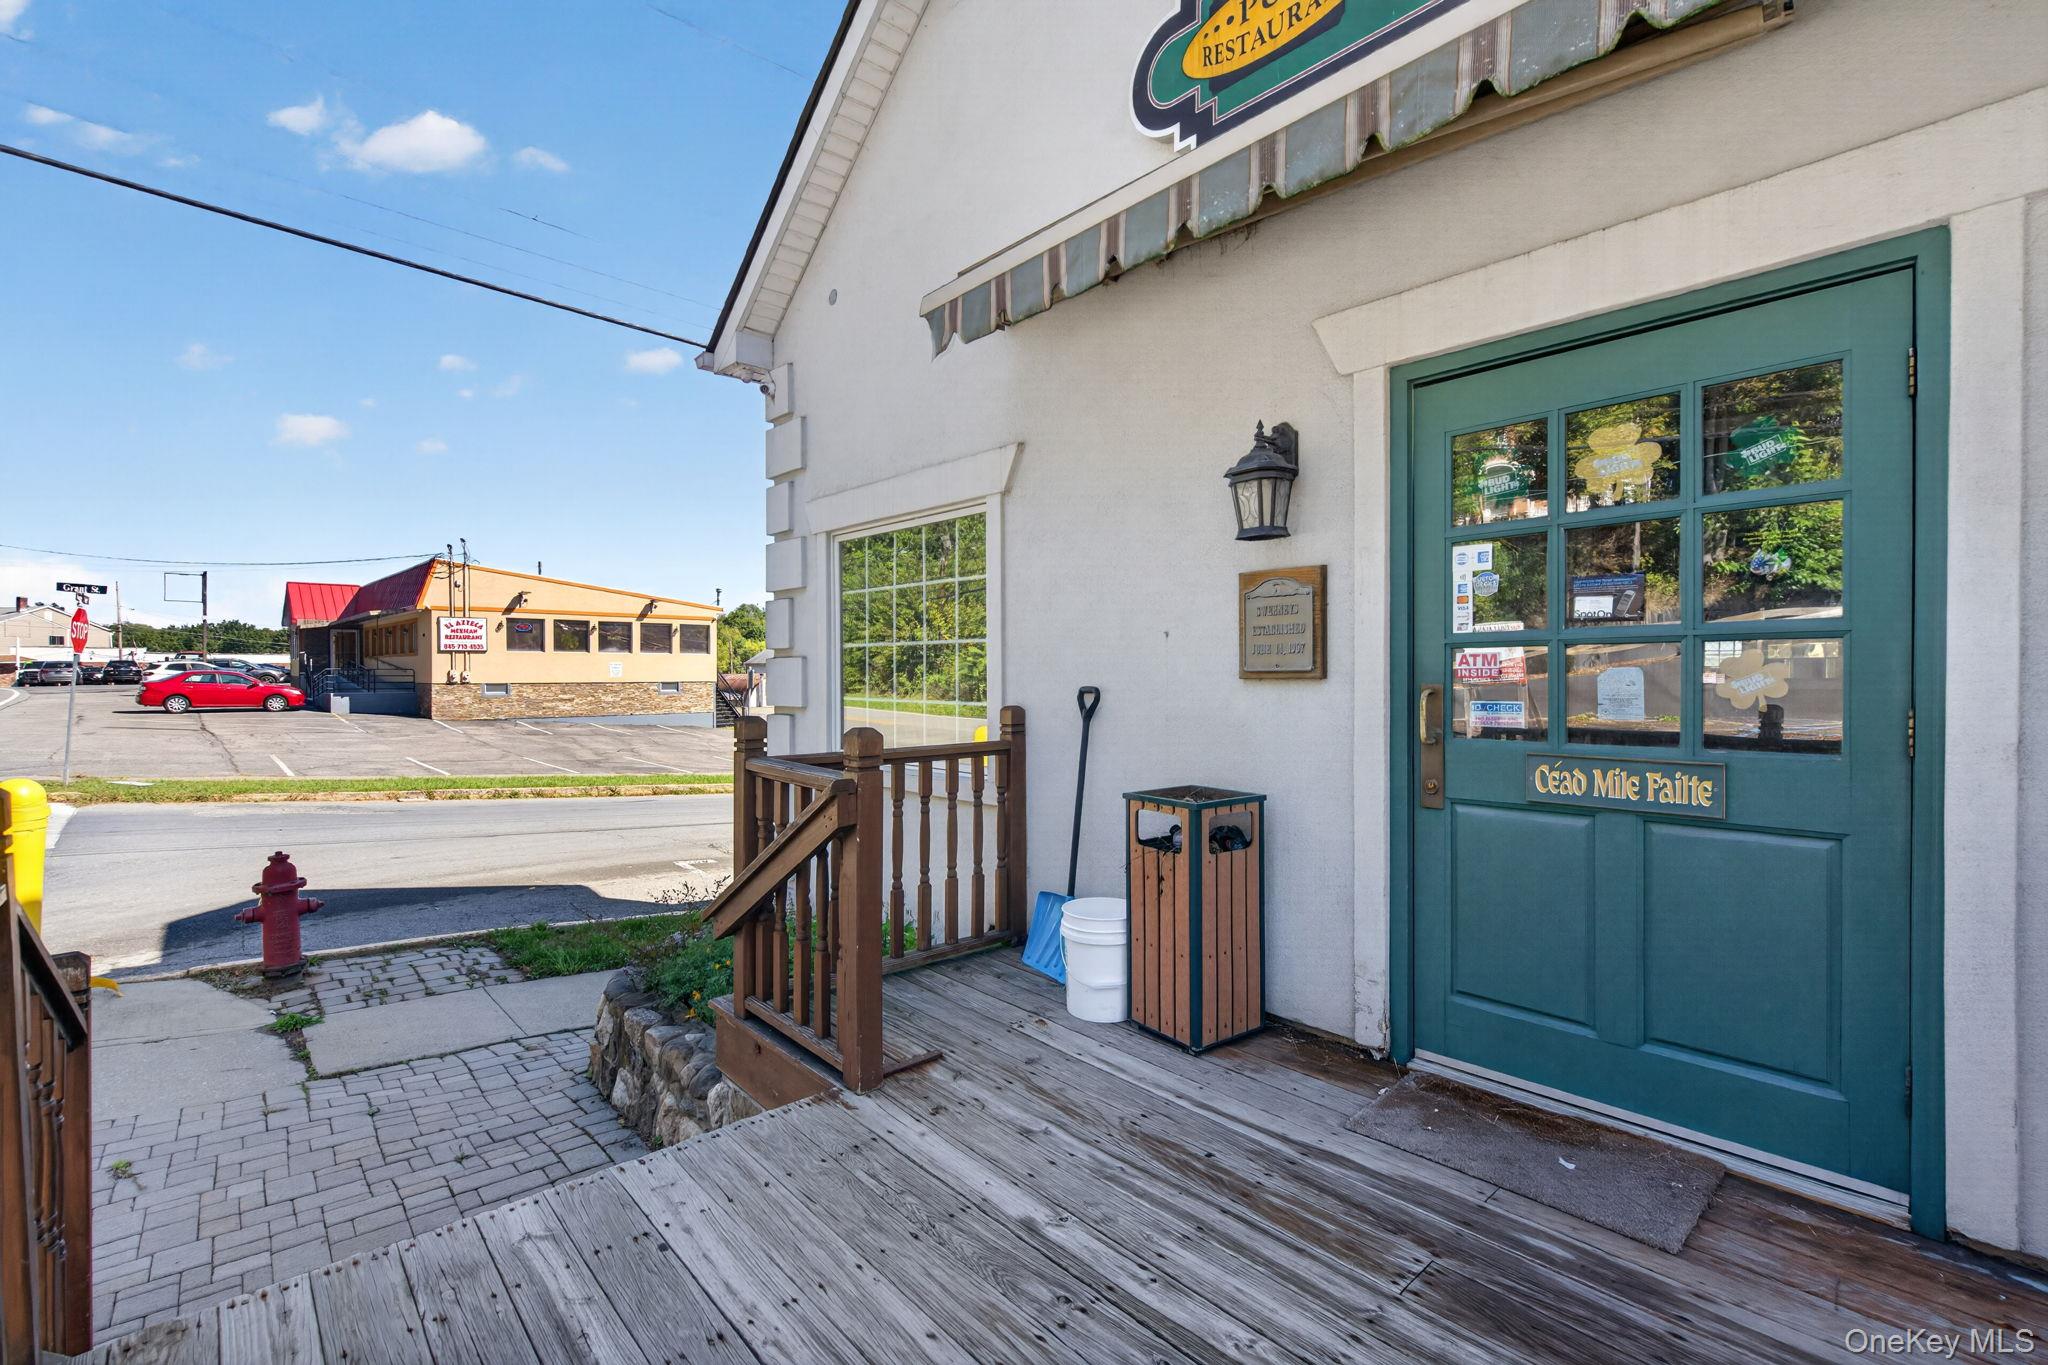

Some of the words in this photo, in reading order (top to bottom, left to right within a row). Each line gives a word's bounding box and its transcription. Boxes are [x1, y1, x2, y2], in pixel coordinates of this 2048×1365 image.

[1202, 0, 1333, 67] RESTAURA
[1751, 440, 1775, 454] BUD
[1749, 445, 1781, 463] LIGHT
[1488, 475, 1510, 487] BUD
[1484, 482, 1515, 495] LIGHT
[63, 584, 88, 593] Grant
[72, 621, 88, 640] STOP
[444, 622, 454, 630] EL
[455, 620, 484, 630] AZTECA
[1458, 654, 1498, 667] ATM
[1457, 669, 1498, 677] INSIDE
[1486, 704, 1521, 712] CHECK
[1534, 760, 1588, 797] Céad
[1592, 767, 1640, 801] Mile
[1645, 771, 1713, 807] Failte
